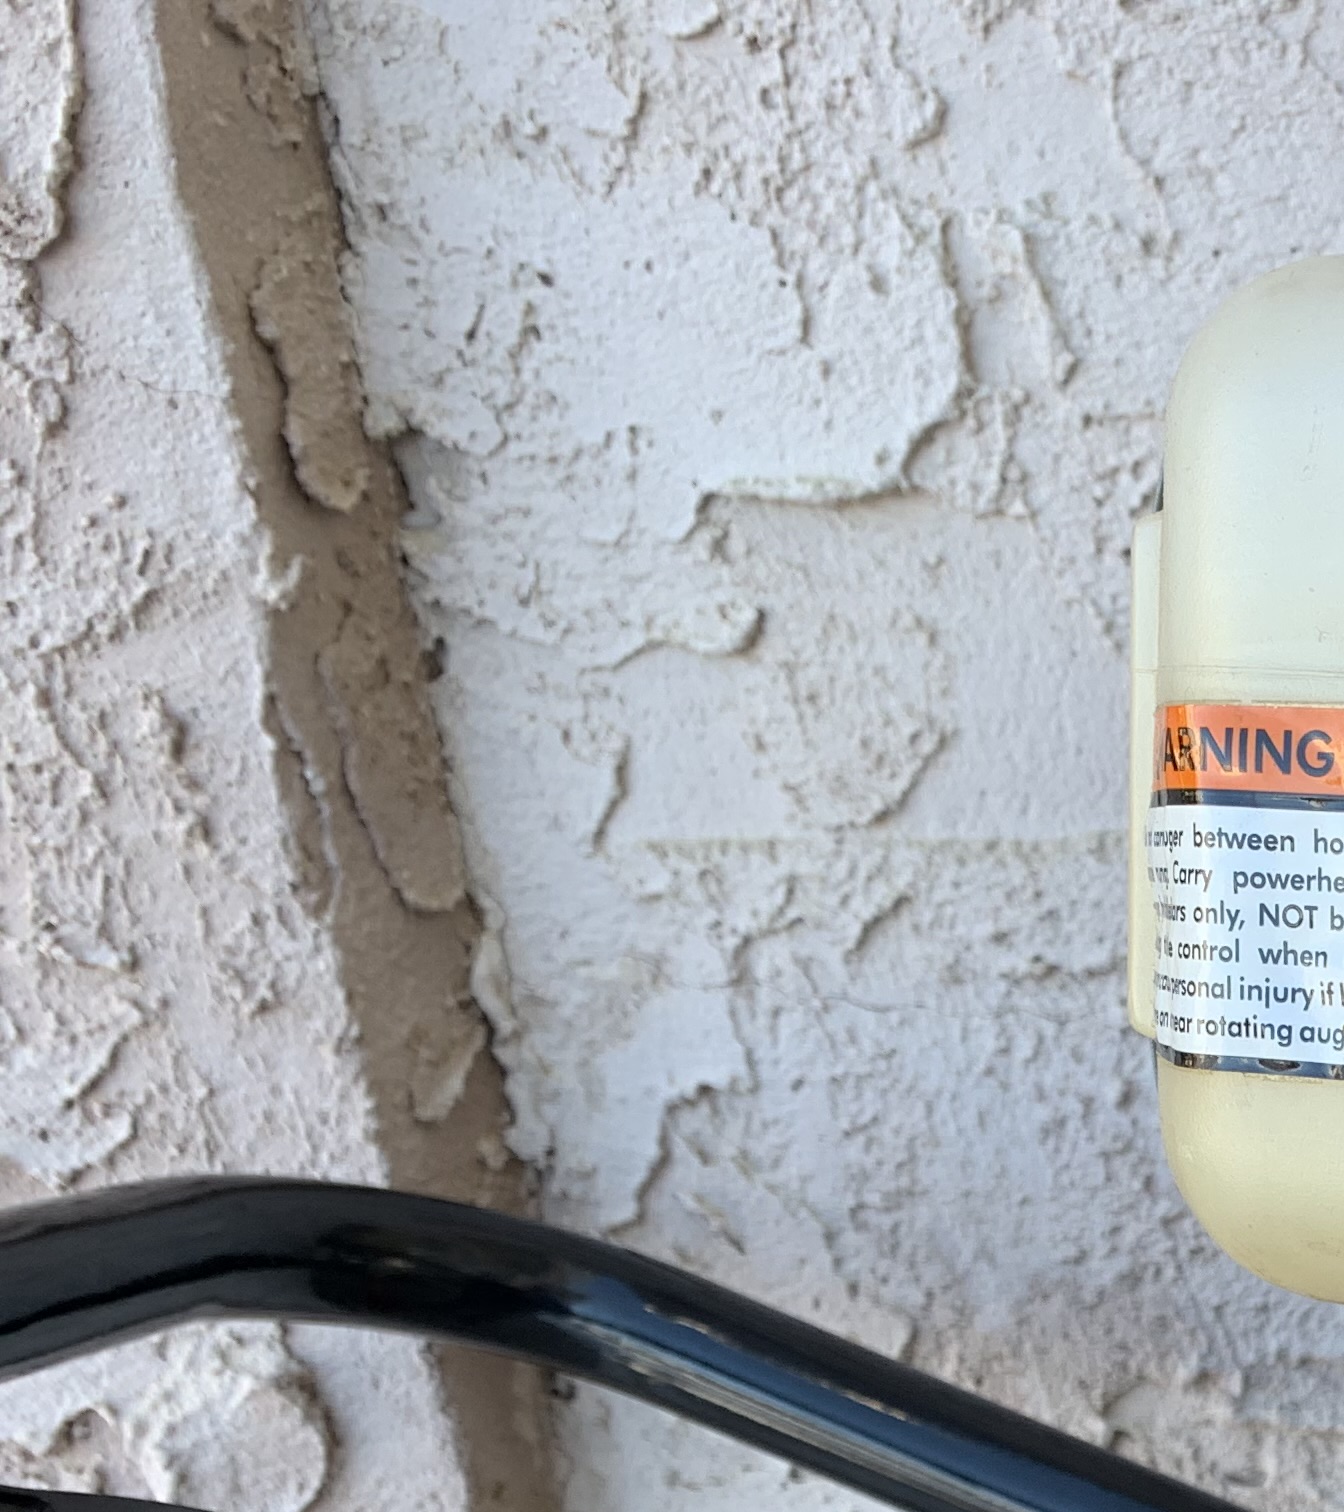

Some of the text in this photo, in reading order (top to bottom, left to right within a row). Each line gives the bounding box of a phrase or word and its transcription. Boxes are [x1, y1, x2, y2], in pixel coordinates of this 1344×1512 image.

[1193, 823, 1296, 853] between
[1172, 860, 1213, 892] Carry
[1193, 901, 1245, 932] only,
[1258, 904, 1318, 929] NOT
[1177, 939, 1240, 963] control
[1258, 941, 1328, 969] when
[1239, 978, 1314, 1011] injury
[1320, 980, 1335, 1005] if
[1197, 1014, 1293, 1048] rotating
